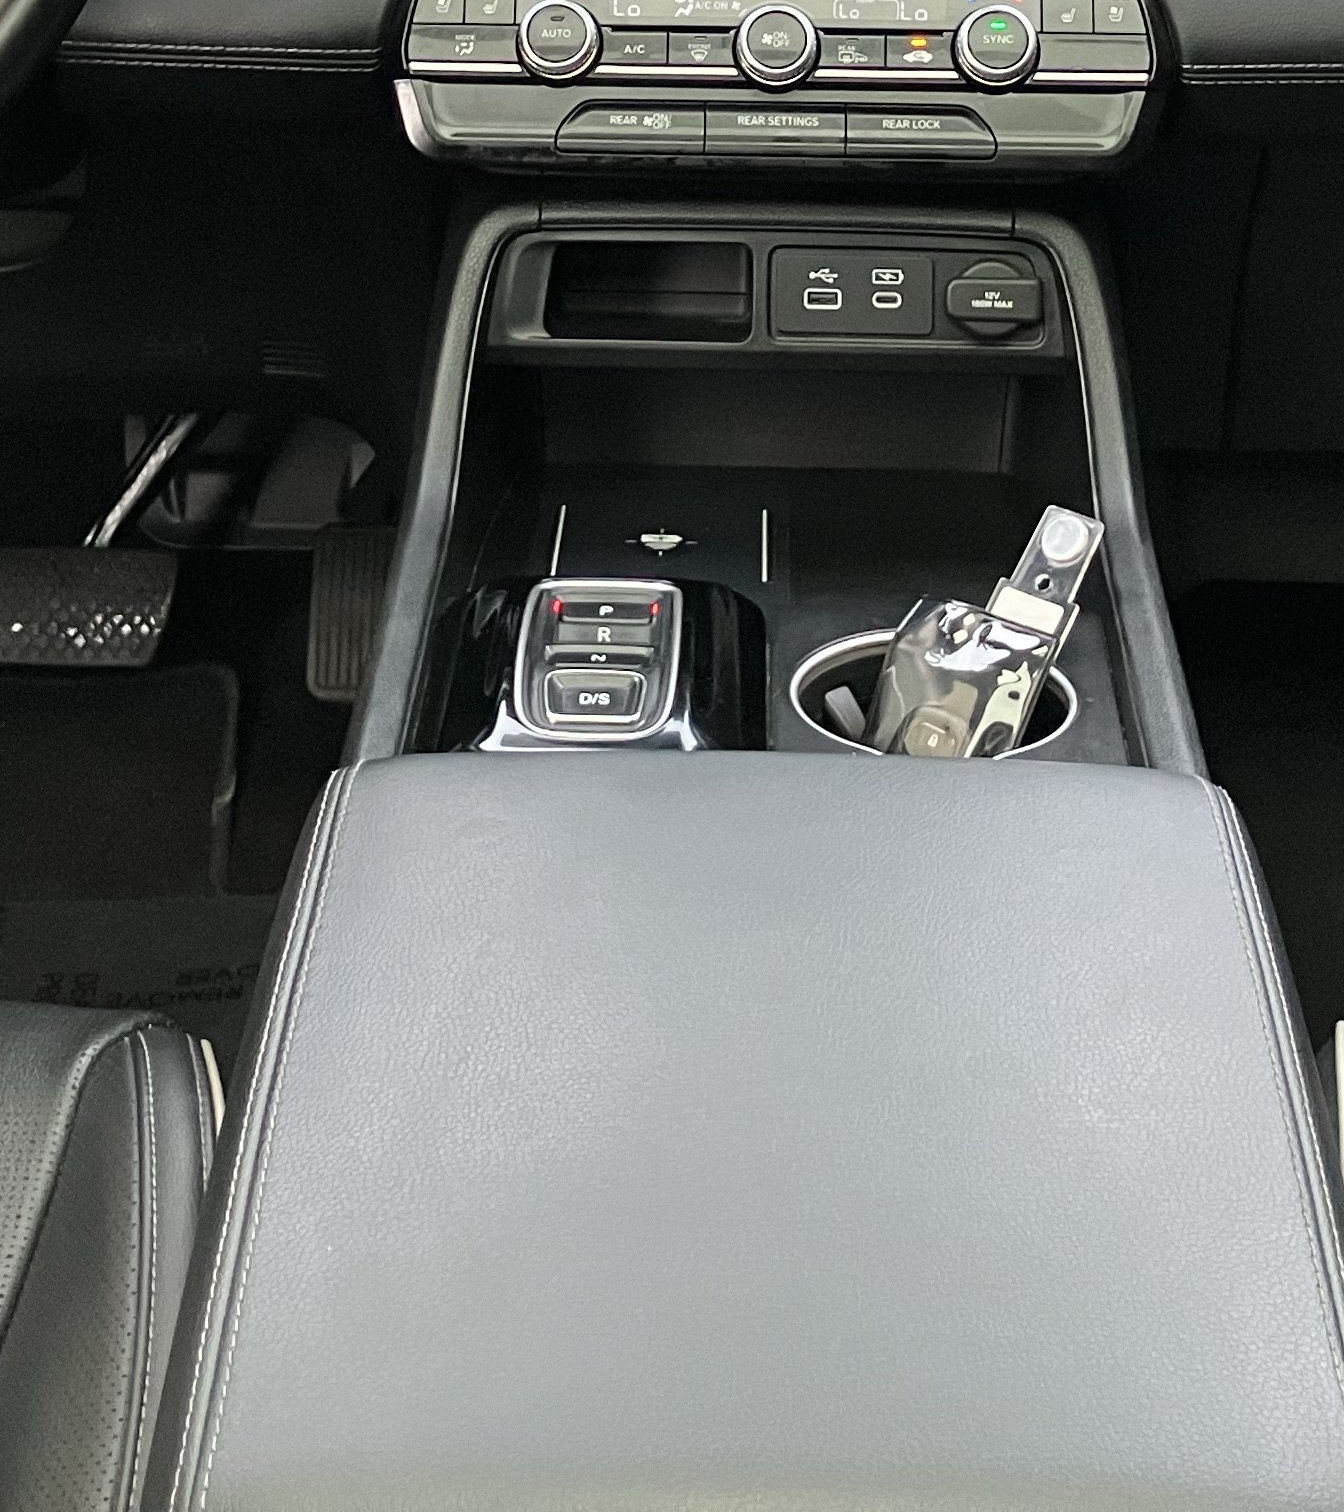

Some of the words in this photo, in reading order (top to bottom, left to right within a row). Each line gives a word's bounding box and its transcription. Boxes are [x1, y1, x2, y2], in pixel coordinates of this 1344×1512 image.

[694, 1, 712, 10] A/C
[713, 1, 728, 10] ON
[541, 28, 572, 38] AUTO
[773, 39, 790, 48] OFF
[983, 35, 1014, 44] SYNC
[623, 44, 646, 54] A/C
[609, 115, 637, 126] REAR
[653, 121, 671, 129] OFF
[737, 115, 766, 126] REAR
[768, 116, 819, 127] SETTINGS
[882, 119, 910, 129] REAR
[912, 119, 940, 130] LOCK
[994, 300, 1013, 308] MAX
[599, 605, 614, 616] P
[597, 626, 611, 642] R
[590, 654, 607, 662] N
[578, 692, 611, 705] D/S
